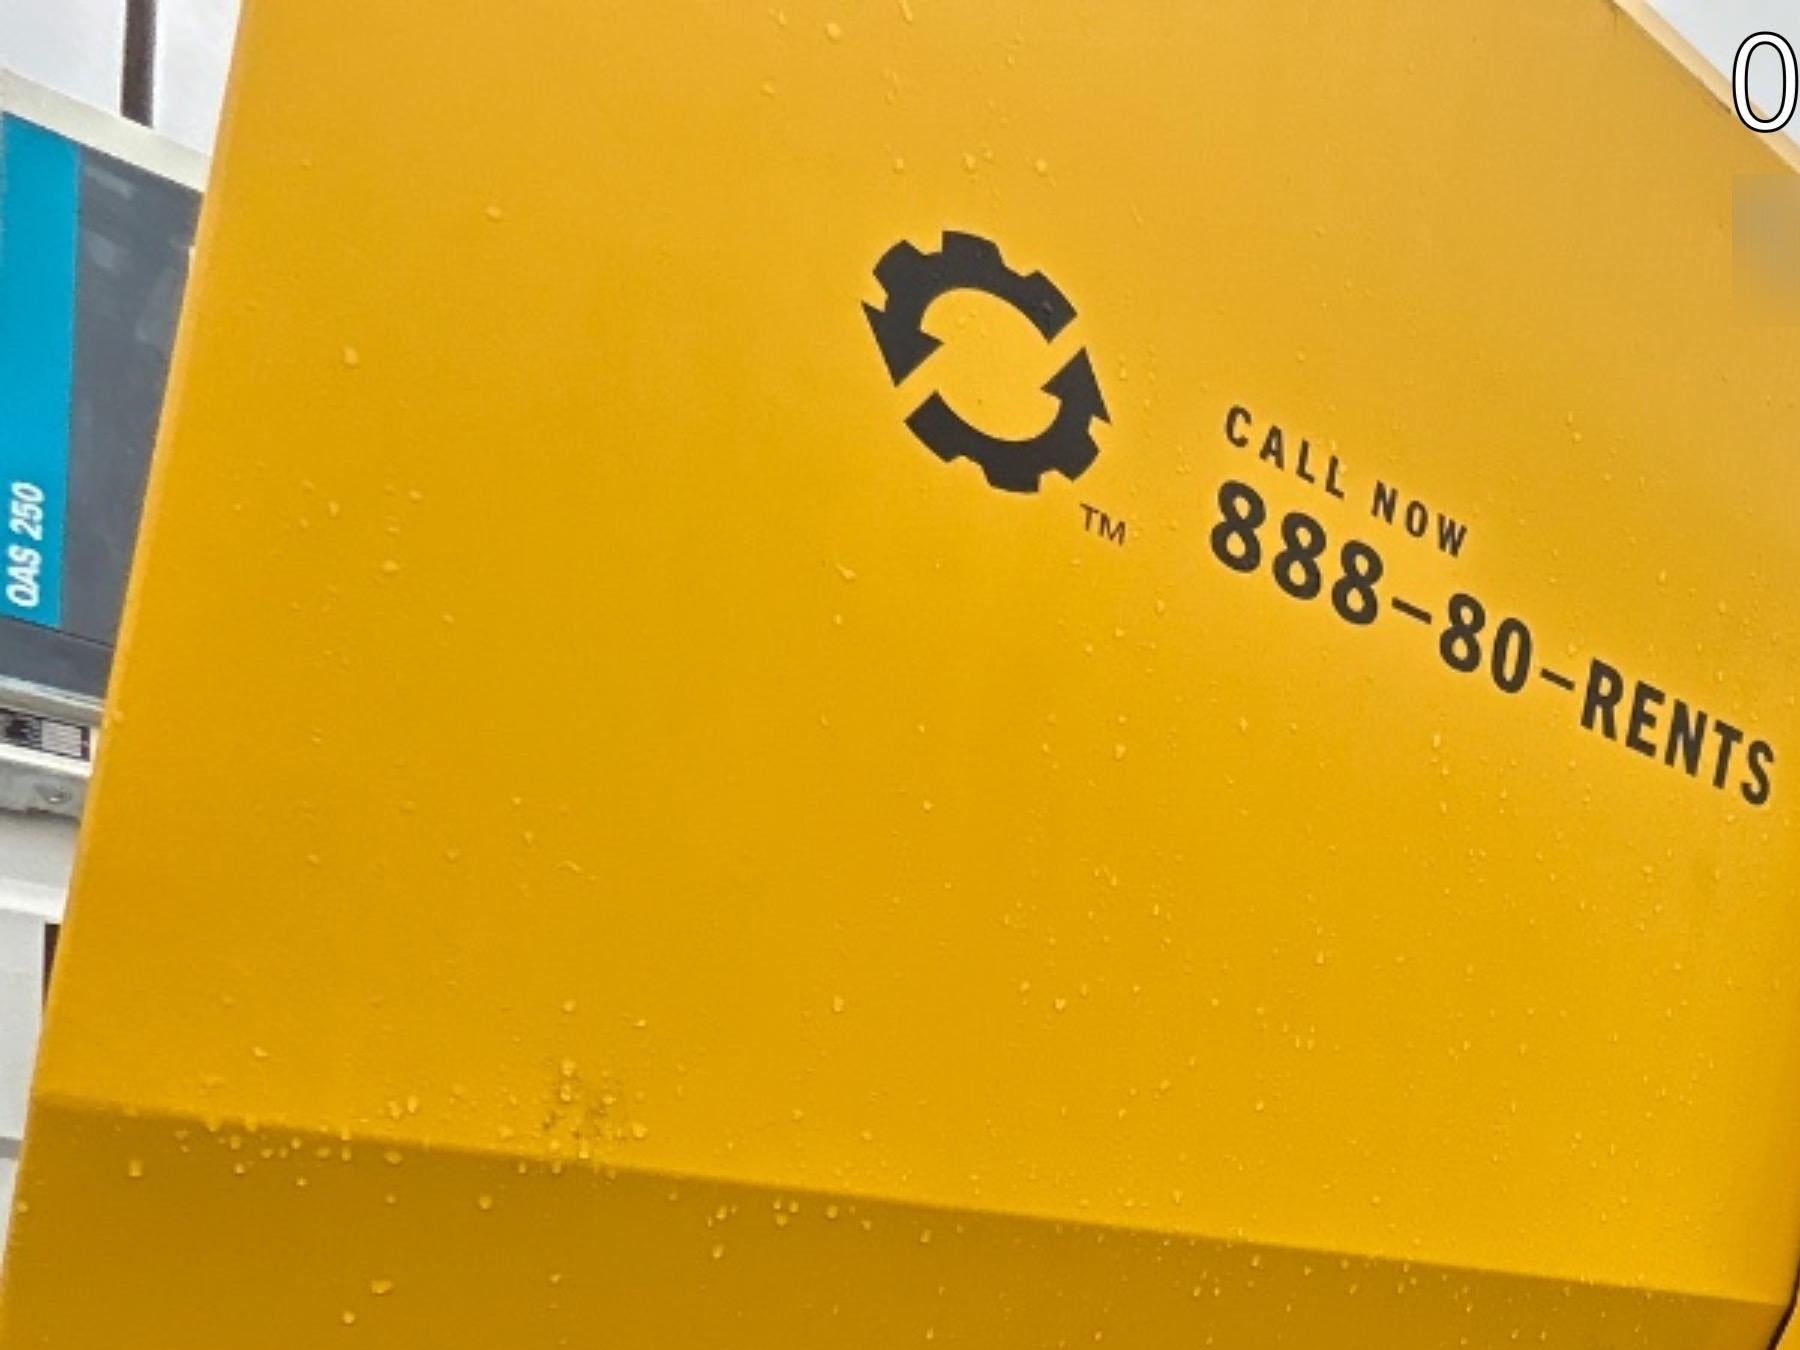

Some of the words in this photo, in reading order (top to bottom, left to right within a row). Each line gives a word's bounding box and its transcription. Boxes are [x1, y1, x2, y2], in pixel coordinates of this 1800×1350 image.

[9, 482, 45, 541] 250
[1080, 503, 1126, 546] TM
[1226, 406, 1344, 499] CALL
[1371, 481, 1467, 557] NOW
[1210, 480, 1774, 805] 888-80-RENTS
